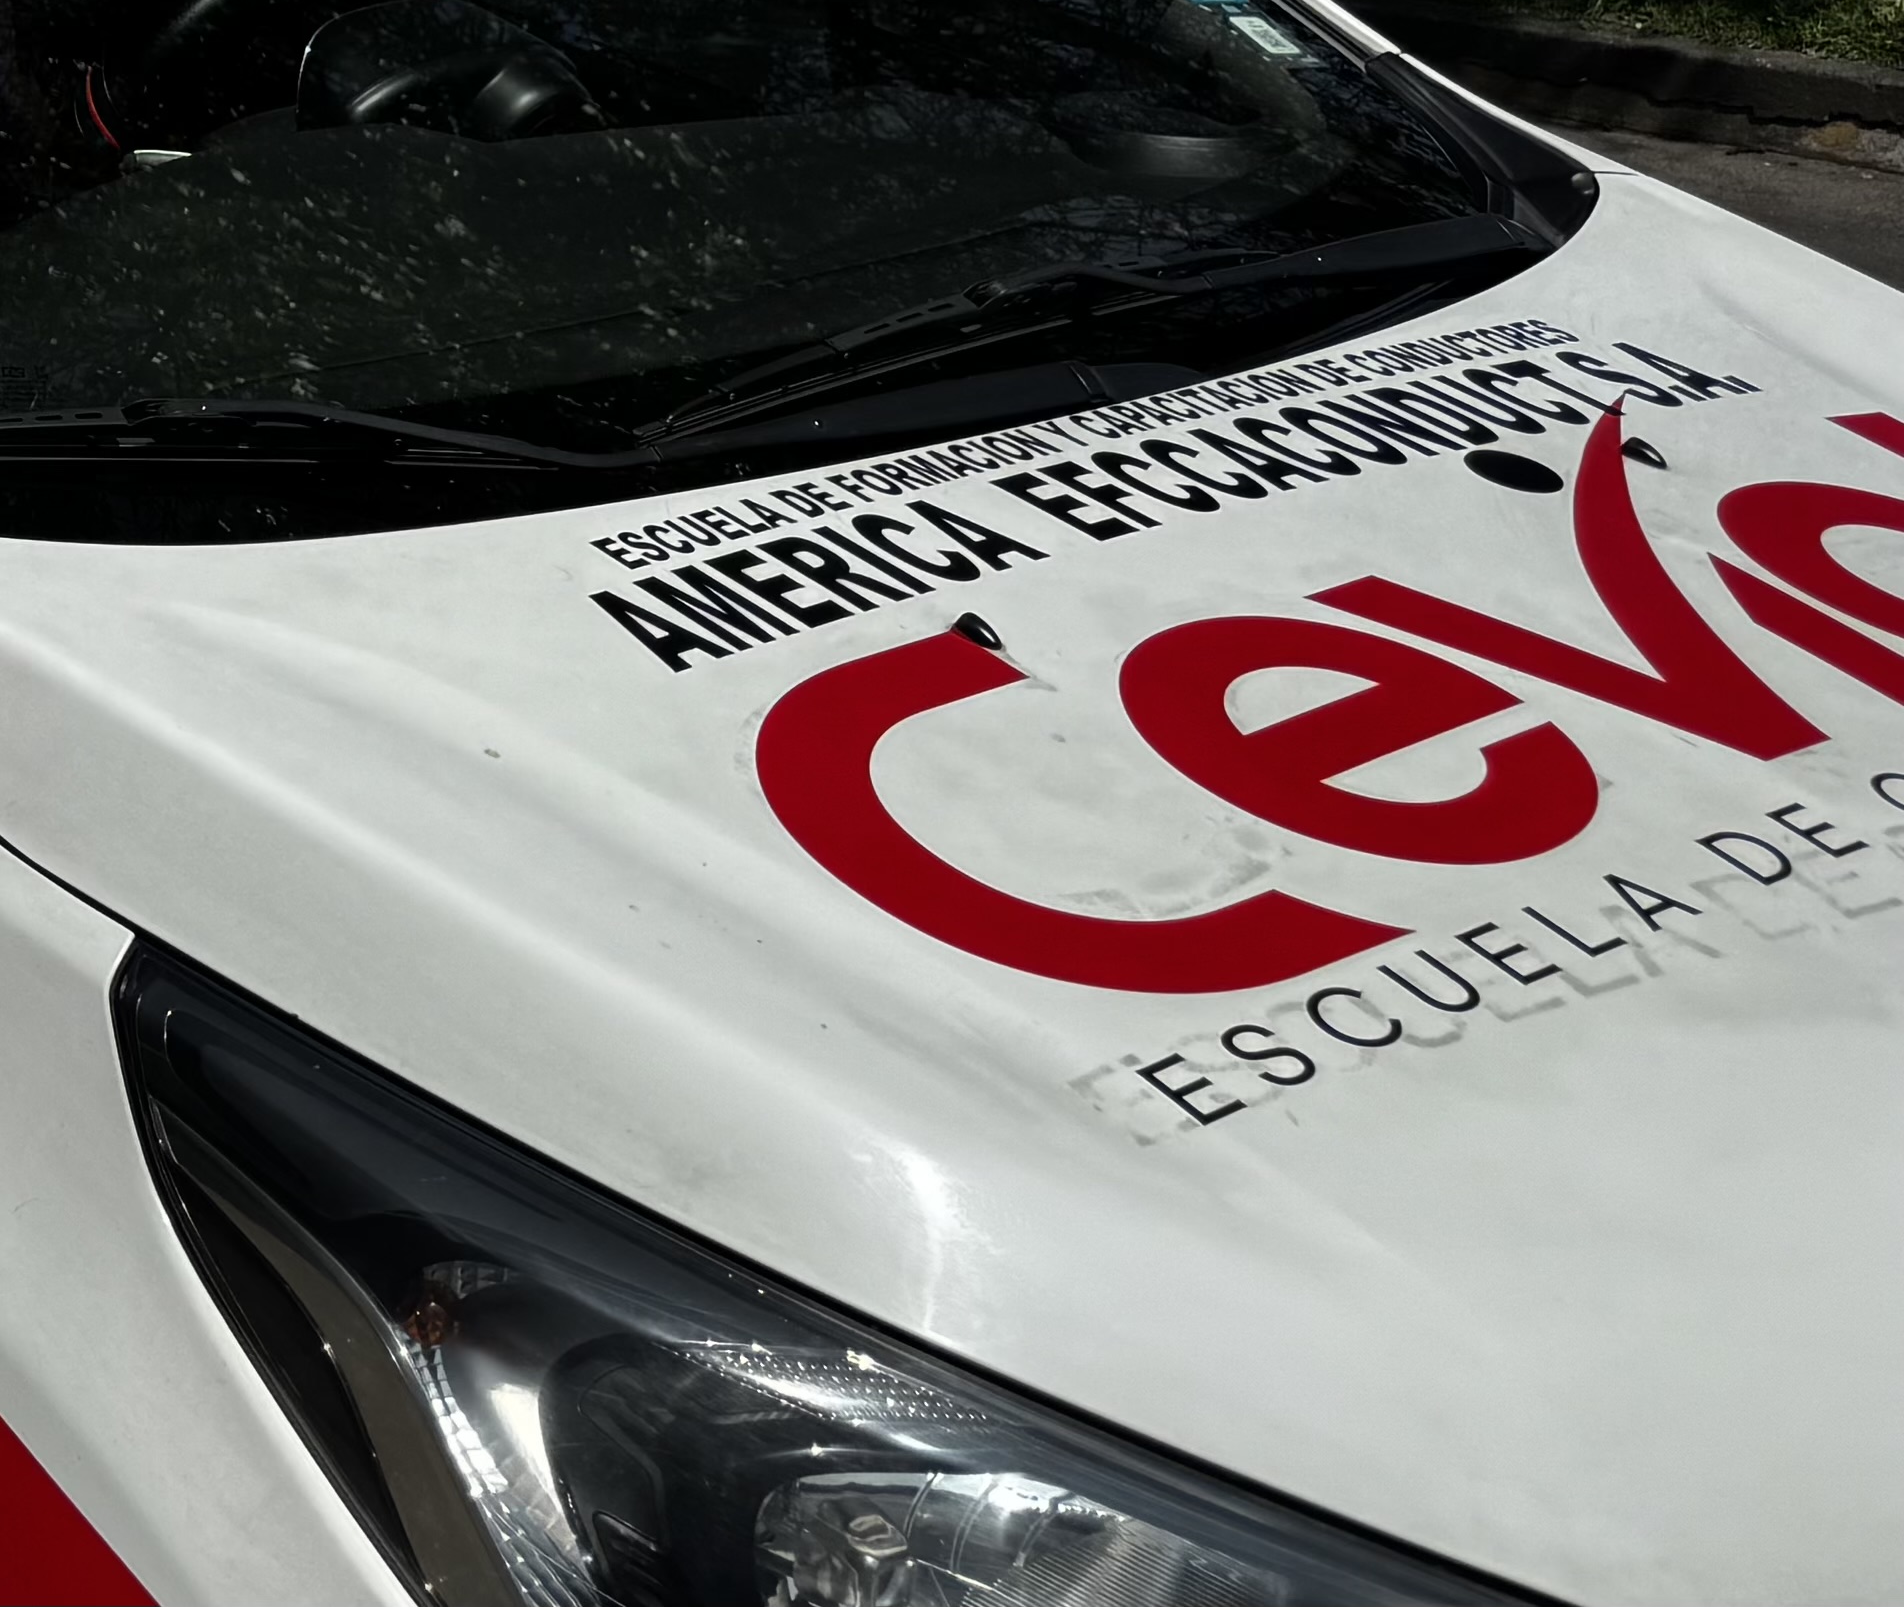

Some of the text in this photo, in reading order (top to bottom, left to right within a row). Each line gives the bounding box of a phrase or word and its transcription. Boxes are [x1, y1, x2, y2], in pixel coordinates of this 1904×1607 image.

[589, 318, 1581, 570] ESCUELA DE FORMACION Y CAPACITACION DE CONDUCTORES
[589, 499, 1052, 674] AMERICA
[1134, 801, 1871, 1128] ESCUELA DE
